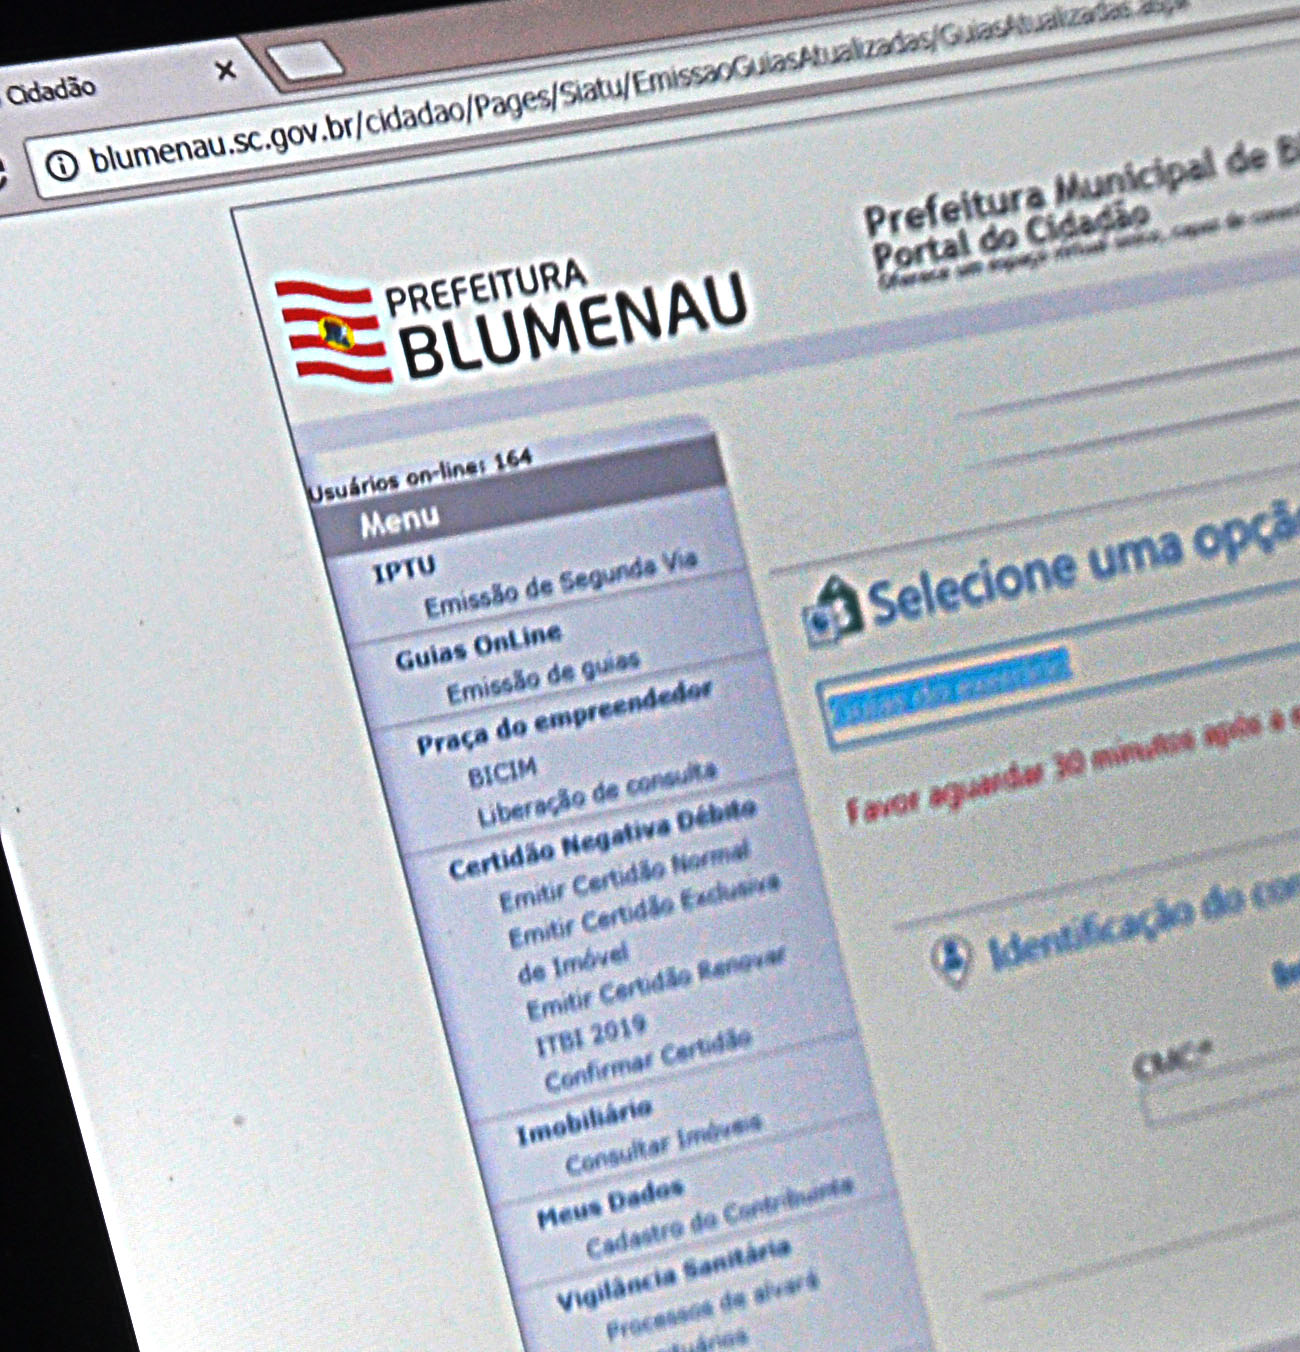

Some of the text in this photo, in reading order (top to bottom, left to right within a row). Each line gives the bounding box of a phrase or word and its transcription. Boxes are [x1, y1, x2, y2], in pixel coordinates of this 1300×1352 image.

[6, 75, 97, 106] Cidadão
[864, 185, 1045, 239] Prefeitura
[1053, 145, 1217, 206] Municipal
[1225, 139, 1268, 175] de
[872, 228, 970, 273] Portal
[979, 222, 1019, 252] do
[1025, 199, 1151, 246] Cidadão
[385, 257, 589, 318] PREFEITURA
[398, 270, 750, 381] BLUMENAU
[308, 447, 535, 505] Usuários on-line: 164
[360, 505, 441, 540] Menu
[373, 554, 437, 584] IPTU
[424, 548, 699, 620] Emissão de Segunda Via
[867, 553, 1078, 627] Selecione
[1088, 531, 1185, 578] uma
[396, 621, 563, 672] Guias OnLine
[446, 650, 642, 706] Emissão de guias
[416, 678, 714, 757] Praça do empreendedor
[467, 756, 539, 789] BICIM
[477, 757, 720, 829] Liberação de consulta
[844, 790, 921, 828] Favor
[928, 762, 1046, 813] aguardar
[1051, 750, 1086, 783] 30
[1091, 726, 1197, 773] minutos
[449, 798, 759, 882] Certidão Negativa Débito
[499, 839, 753, 914] Emitir Certidão Normal
[508, 871, 783, 951] Emitir Certidão Exclusiva
[517, 940, 630, 987] de Imóvel
[988, 895, 1196, 974] Identificação
[1200, 883, 1247, 922] do
[526, 944, 787, 1023] Emitir Certidão Renovar
[536, 1012, 648, 1060] ITBI 2019
[544, 1027, 754, 1096] Confirmar Certidão
[516, 1098, 654, 1149] Imobiliário
[565, 1112, 764, 1177] Consultar Imóveis
[537, 1177, 686, 1231] Meus Dados
[585, 1223, 686, 1262] Cadastro
[690, 1210, 718, 1234] do
[556, 1236, 793, 1313] Vigilância Sanitária
[606, 1267, 820, 1342] Processos de alvará
